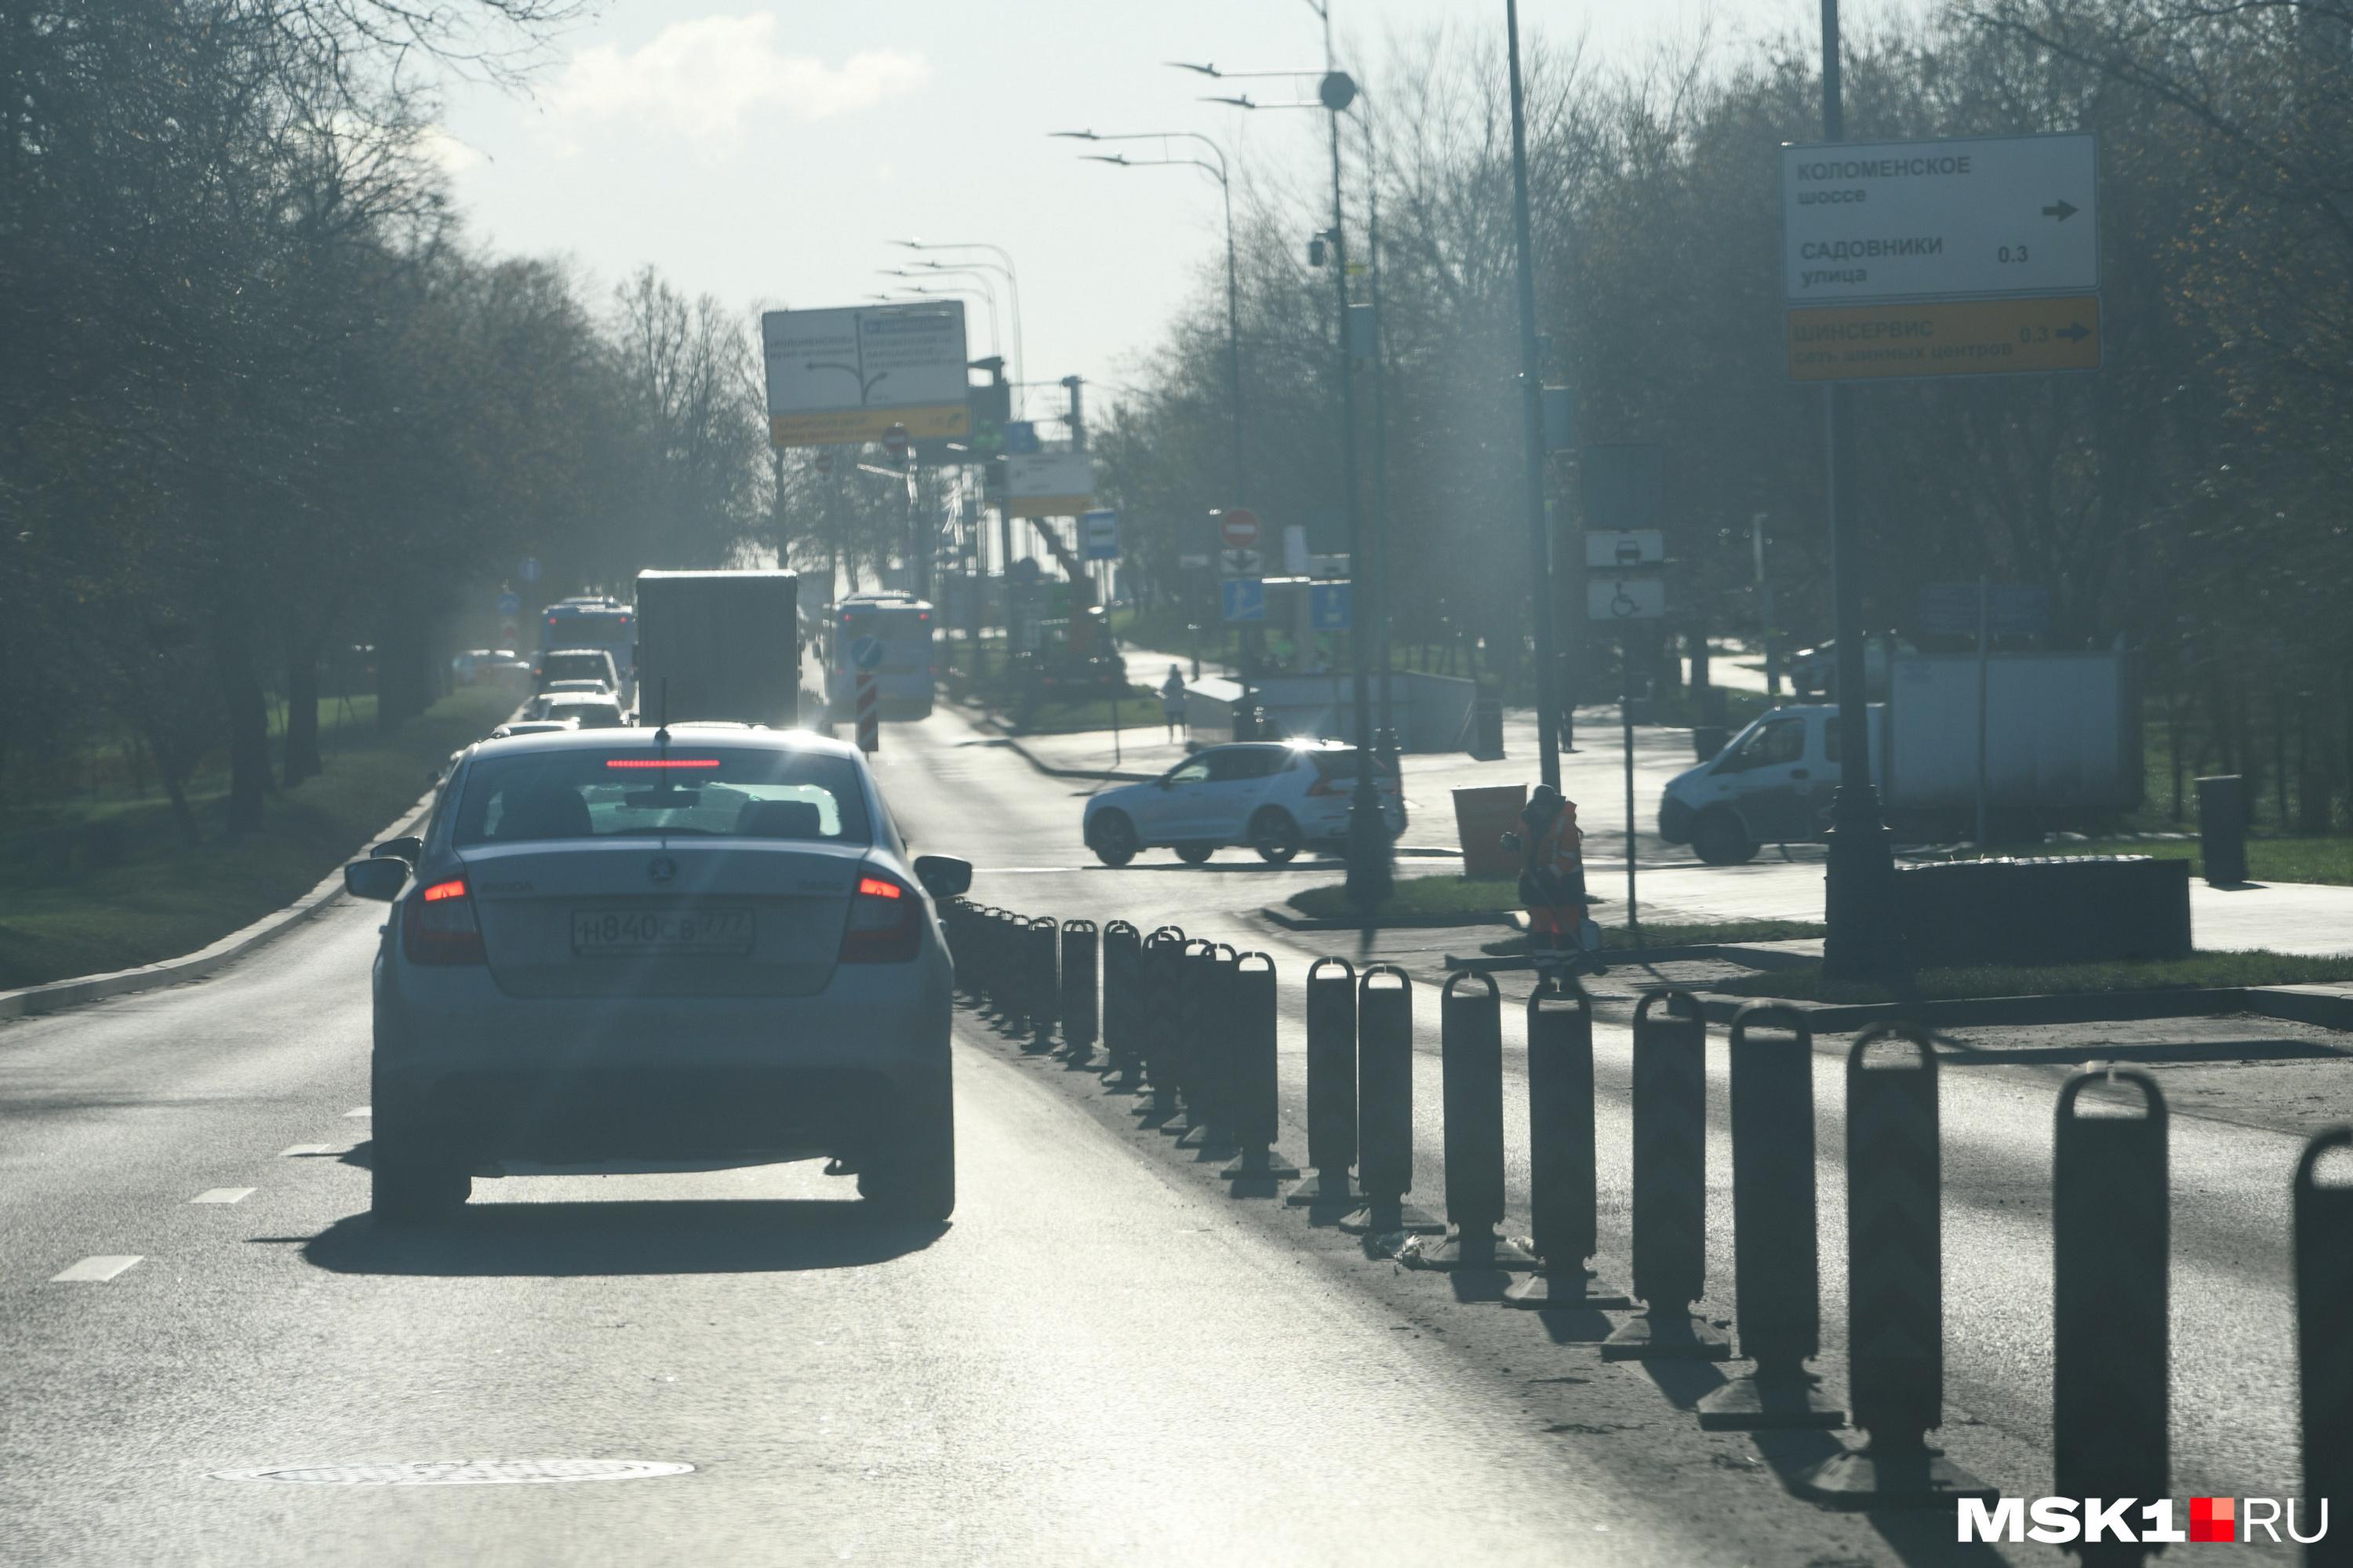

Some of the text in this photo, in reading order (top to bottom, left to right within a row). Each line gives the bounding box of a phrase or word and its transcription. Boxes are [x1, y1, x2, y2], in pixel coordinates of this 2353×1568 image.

[1797, 156, 1971, 181] КОЛОМЕНСКОЕ
[1798, 188, 1867, 205] шоссе
[1801, 237, 2029, 264] САДОВНИКИ 0.3
[1800, 268, 1867, 288] улица
[1794, 321, 2049, 343] ШИНСЕРВИС 0.3
[1795, 343, 2013, 364] сеть шинных центров
